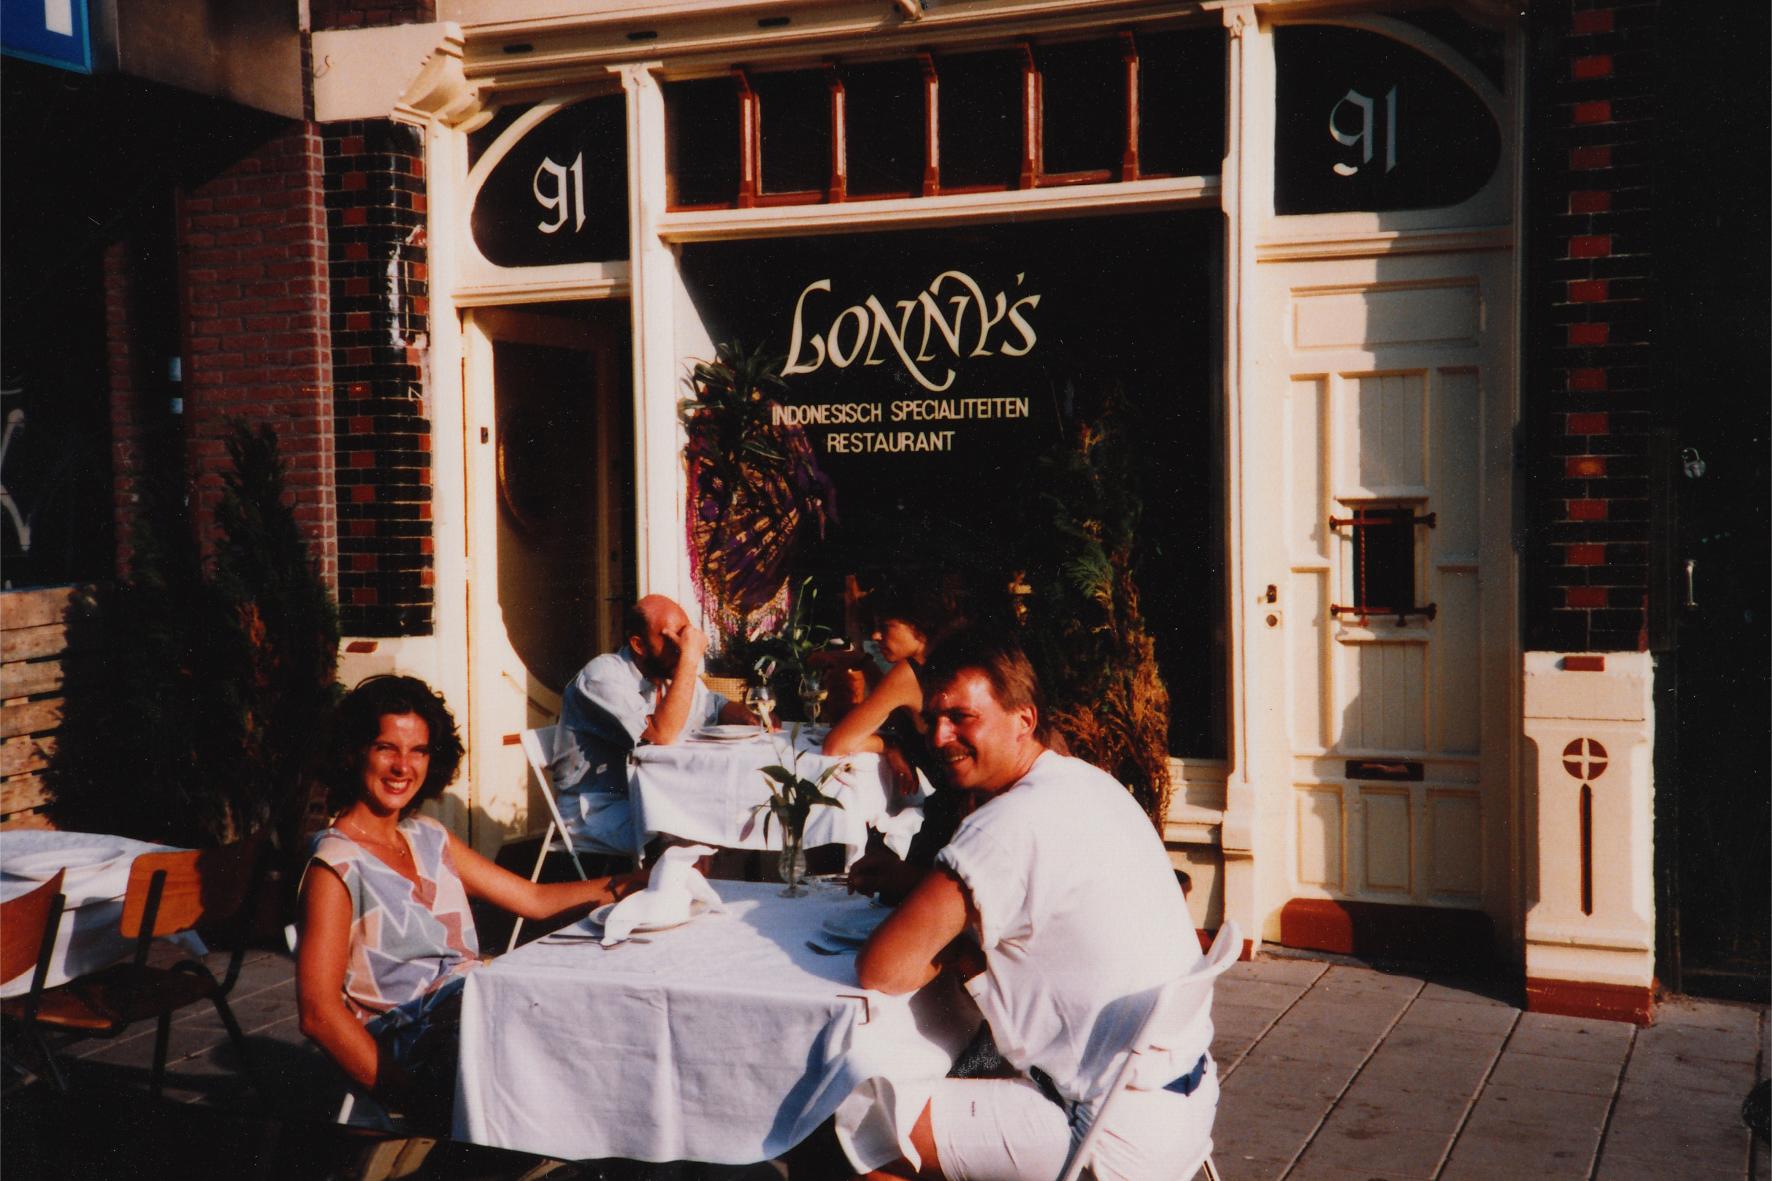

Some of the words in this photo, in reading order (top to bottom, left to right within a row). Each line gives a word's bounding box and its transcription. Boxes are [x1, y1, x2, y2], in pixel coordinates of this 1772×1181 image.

[1329, 85, 1397, 176] 91
[533, 151, 586, 233] 91
[772, 403, 882, 426] INDONESISCH
[890, 397, 1029, 421] SPECIALITEITEN
[827, 431, 955, 453] RESTAURANT
